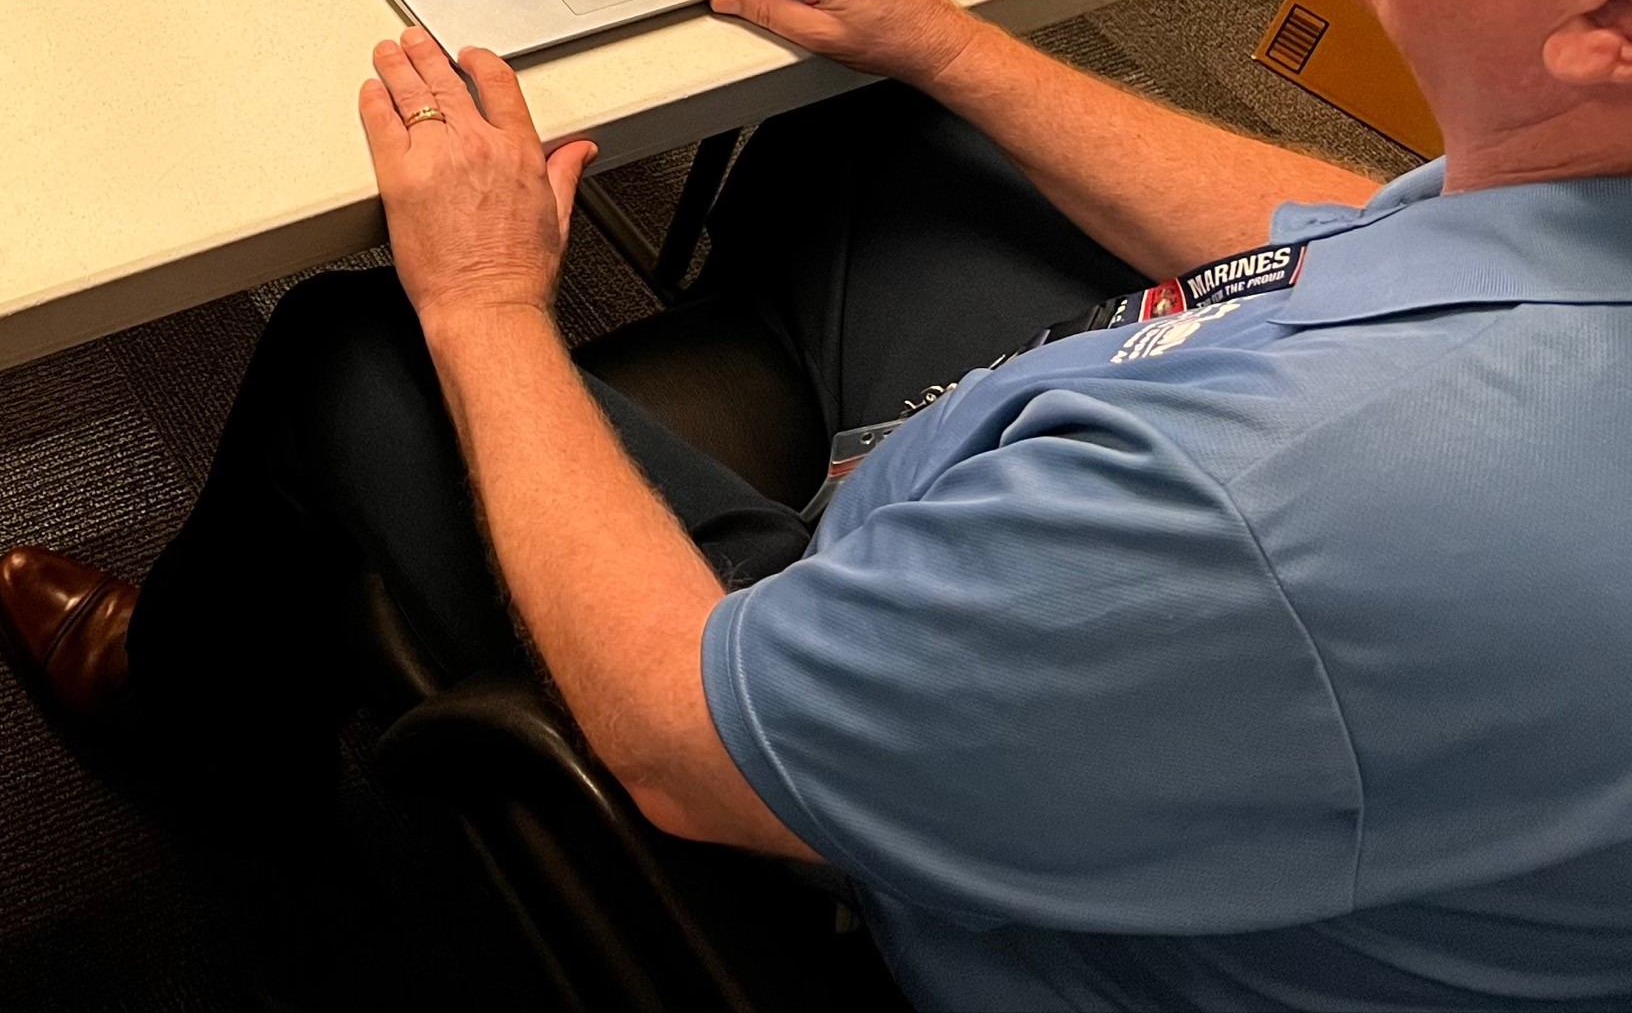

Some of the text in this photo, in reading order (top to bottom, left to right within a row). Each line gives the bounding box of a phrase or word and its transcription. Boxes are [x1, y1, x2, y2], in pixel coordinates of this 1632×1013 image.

[1187, 247, 1291, 299] MARINES
[1225, 281, 1245, 296] THE
[1246, 270, 1285, 289] PROUD
